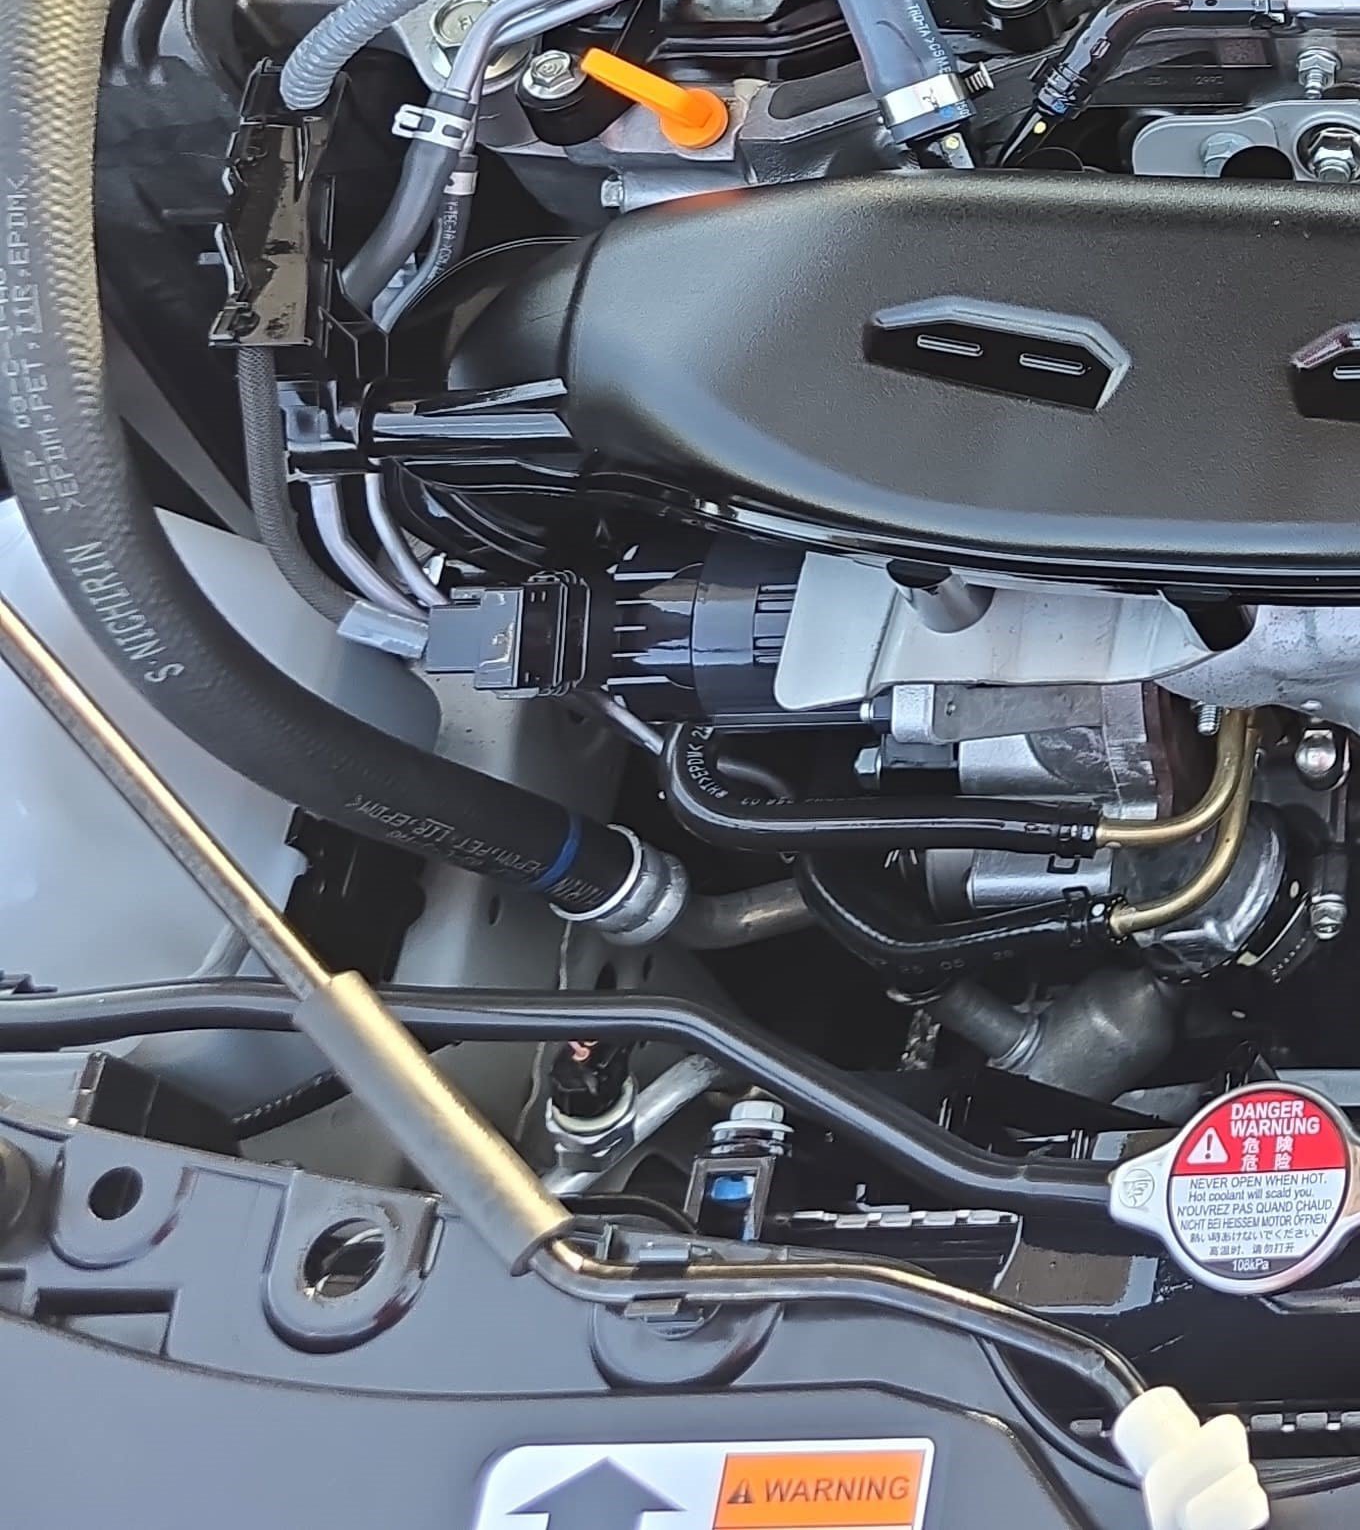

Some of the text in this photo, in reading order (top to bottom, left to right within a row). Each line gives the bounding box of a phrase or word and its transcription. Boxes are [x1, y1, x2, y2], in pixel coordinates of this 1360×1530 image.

[1231, 1100, 1304, 1120] DANGER
[1230, 1117, 1320, 1137] WARNUNG
[1190, 1173, 1327, 1190] NEVER OPEN WHEN HOT.
[1189, 1187, 1314, 1202] Hot coolant will scald you.
[1177, 1204, 1230, 1217] N'OUVREZ
[1232, 1203, 1254, 1215] PAS
[1255, 1201, 1294, 1214] QUAND
[1180, 1218, 1206, 1231] NICHT
[1207, 1218, 1222, 1230] BEI
[1222, 1216, 1260, 1230] HEISSEM
[1261, 1215, 1292, 1227] MOTOR
[1231, 1258, 1270, 1272] 108kPa
[764, 1474, 911, 1504] WARNING
